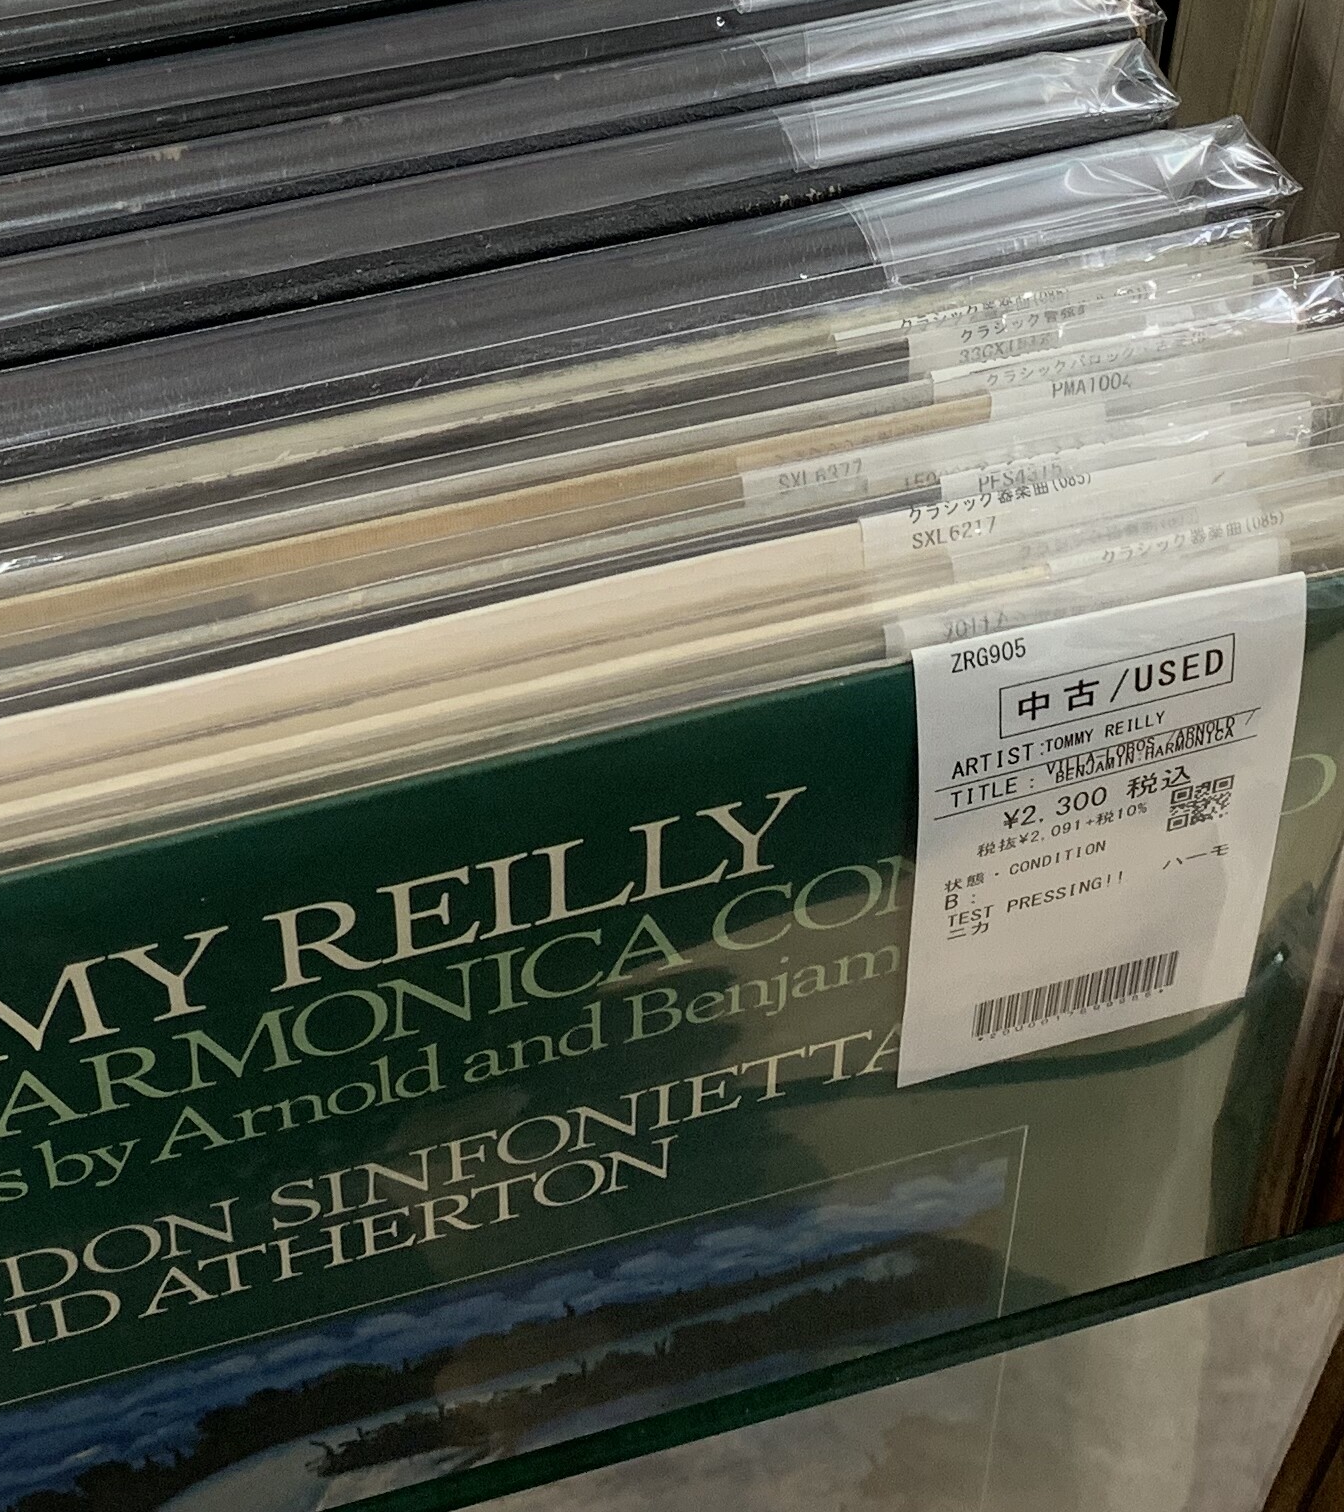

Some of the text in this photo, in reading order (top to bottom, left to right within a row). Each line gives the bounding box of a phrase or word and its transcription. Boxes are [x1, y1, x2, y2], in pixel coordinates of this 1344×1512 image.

[951, 637, 1027, 674] ZRG905
[1016, 648, 1225, 723] 中古/USED
[1045, 728, 1094, 753] TOMMY
[1104, 710, 1166, 738] REILLY
[1126, 765, 1192, 800] 税込
[262, 786, 808, 994] REILLY
[948, 904, 995, 928] TEST
[1006, 870, 1124, 914] PRESSING!!
[44, 1138, 141, 1195] by
[151, 1051, 444, 1162] Arnold
[463, 1010, 607, 1083] and
[622, 943, 902, 1043] Benjam
[137, 1135, 680, 1319] ATHERTON
